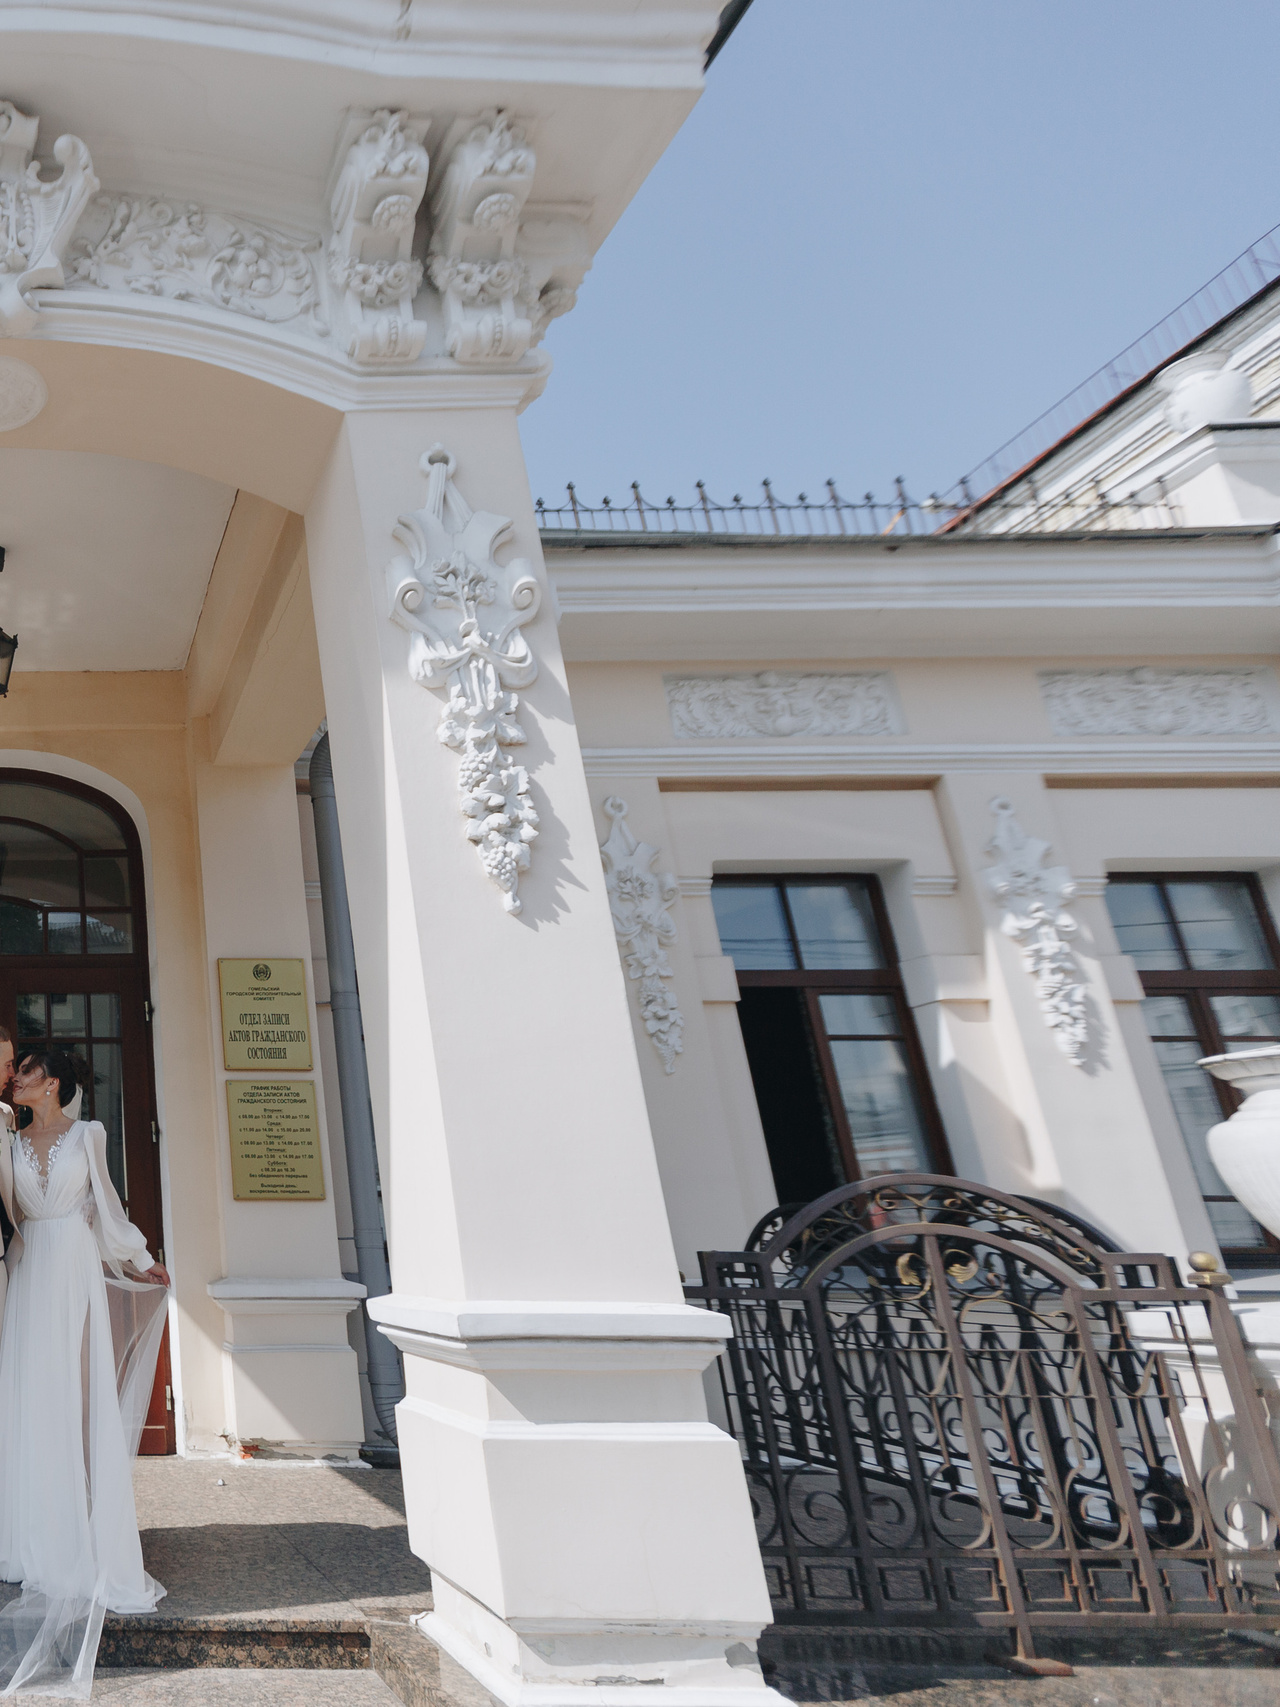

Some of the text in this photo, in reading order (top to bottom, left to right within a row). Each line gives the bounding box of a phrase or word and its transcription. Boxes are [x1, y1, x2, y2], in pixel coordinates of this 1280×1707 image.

[239, 1013, 290, 1027] ОТДЕЛ ЗАПИСИ
[228, 1030, 306, 1044] АКТОВ ГРАЖДАНСКОГО
[247, 1047, 287, 1059] СОСТОЯНИЯ
